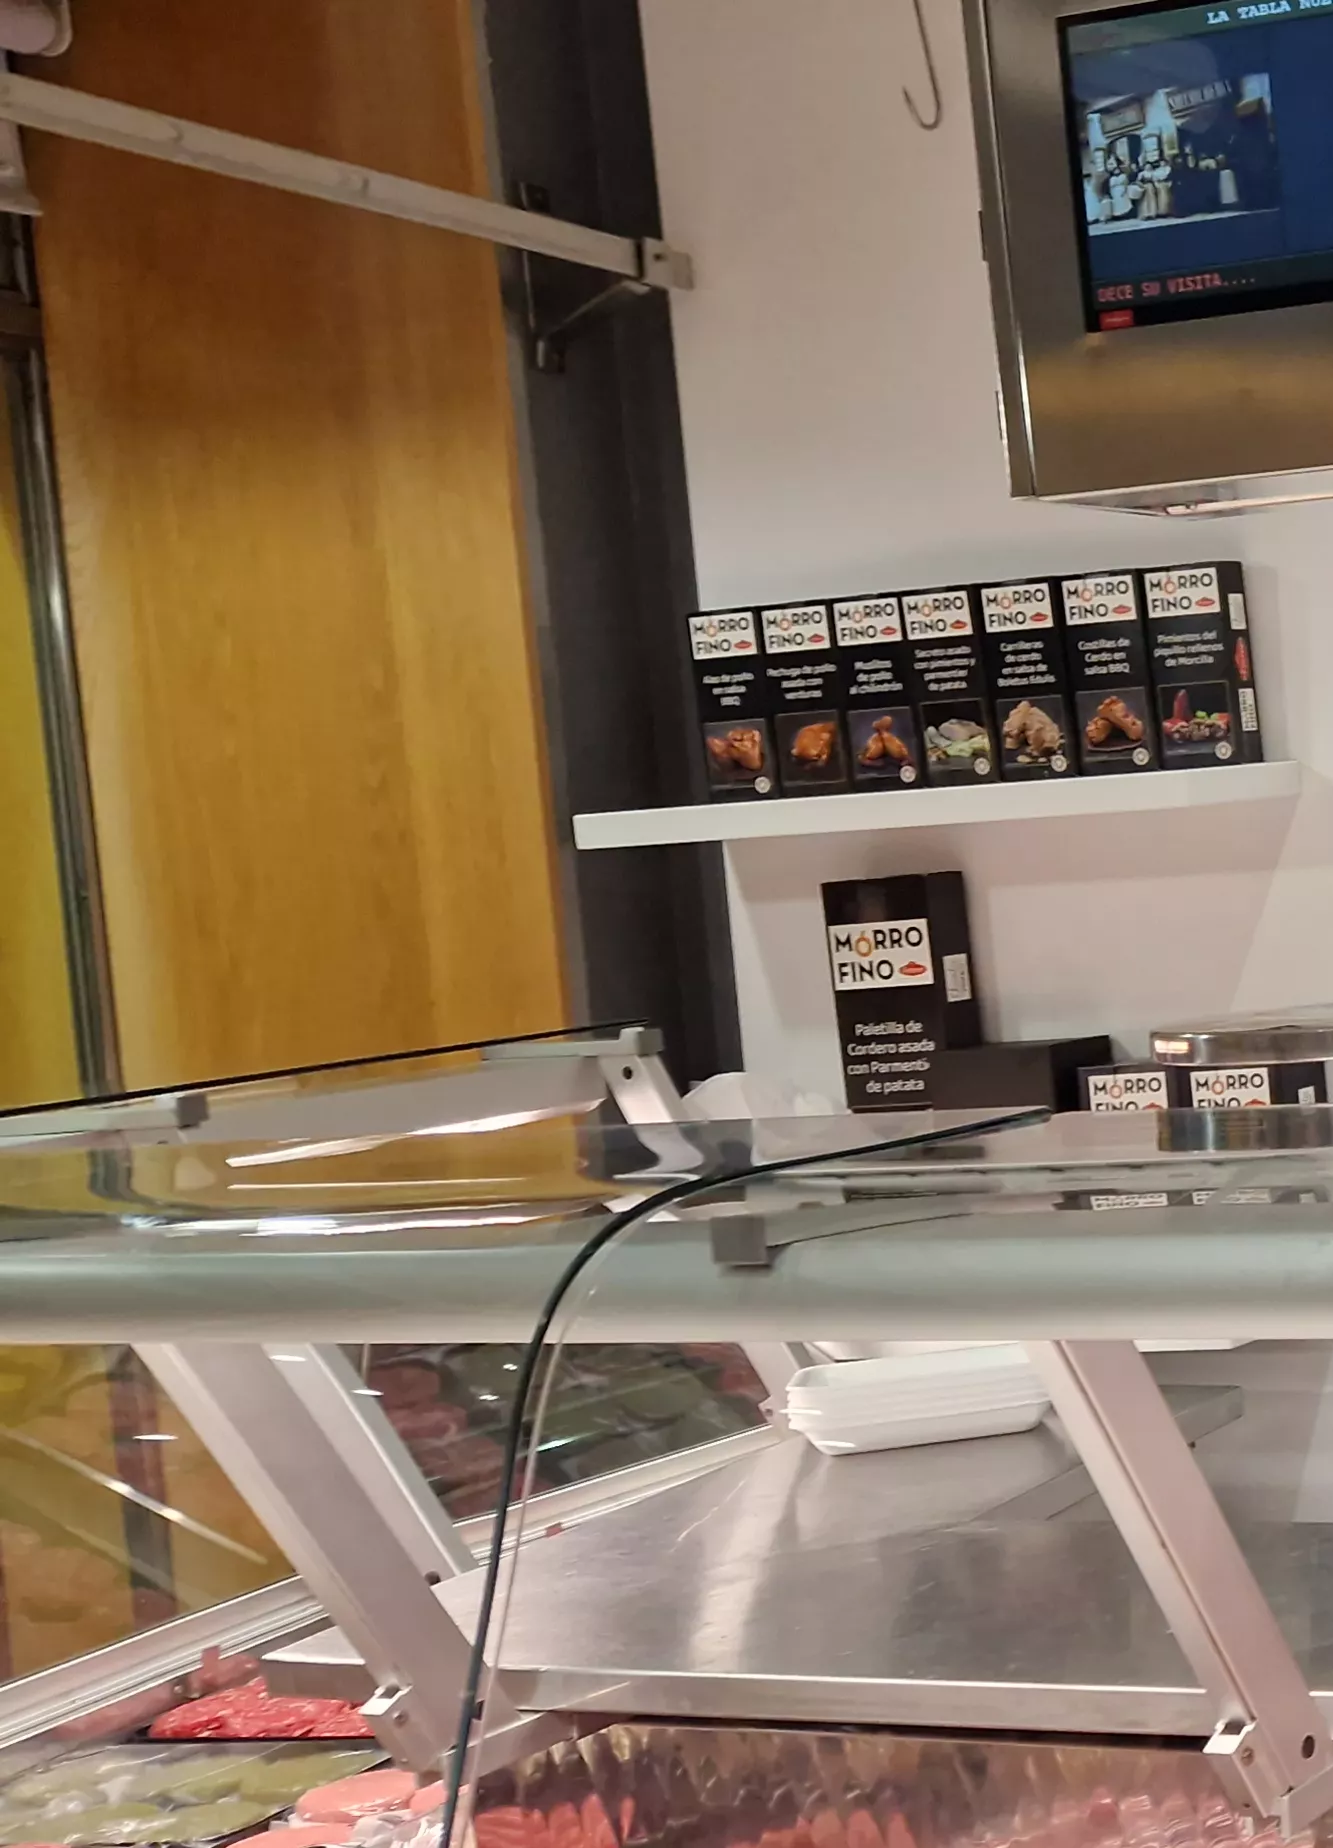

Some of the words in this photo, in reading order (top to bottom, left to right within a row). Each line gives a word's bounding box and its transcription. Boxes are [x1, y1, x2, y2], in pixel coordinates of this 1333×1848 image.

[1206, 11, 1230, 25] LA
[1237, 1, 1292, 19] TABLA
[1066, 580, 1129, 602] MORRO
[1149, 572, 1214, 594] MORRO
[907, 596, 965, 617] MORRO
[986, 588, 1046, 610] MORRO
[1151, 596, 1192, 613] FINO
[766, 610, 822, 631] MORRO
[838, 602, 895, 623] MORRO
[988, 611, 1027, 628] FINO
[1069, 603, 1109, 620] FINO
[693, 616, 749, 638] MORRO
[841, 625, 877, 641] FINO
[910, 618, 947, 635] FINO
[696, 639, 731, 654] FINO
[768, 632, 804, 648] FINO
[834, 926, 923, 957] MORRO
[838, 959, 894, 983] FINO
[855, 1021, 904, 1036] Paletilla
[905, 1020, 923, 1033] de
[847, 1041, 897, 1056] Cordero
[897, 1038, 936, 1053] asada
[847, 1062, 869, 1075] con
[865, 1080, 882, 1093] de
[883, 1078, 925, 1095] patata
[1093, 1075, 1163, 1099] MORRO
[1195, 1072, 1265, 1096] MORRO
